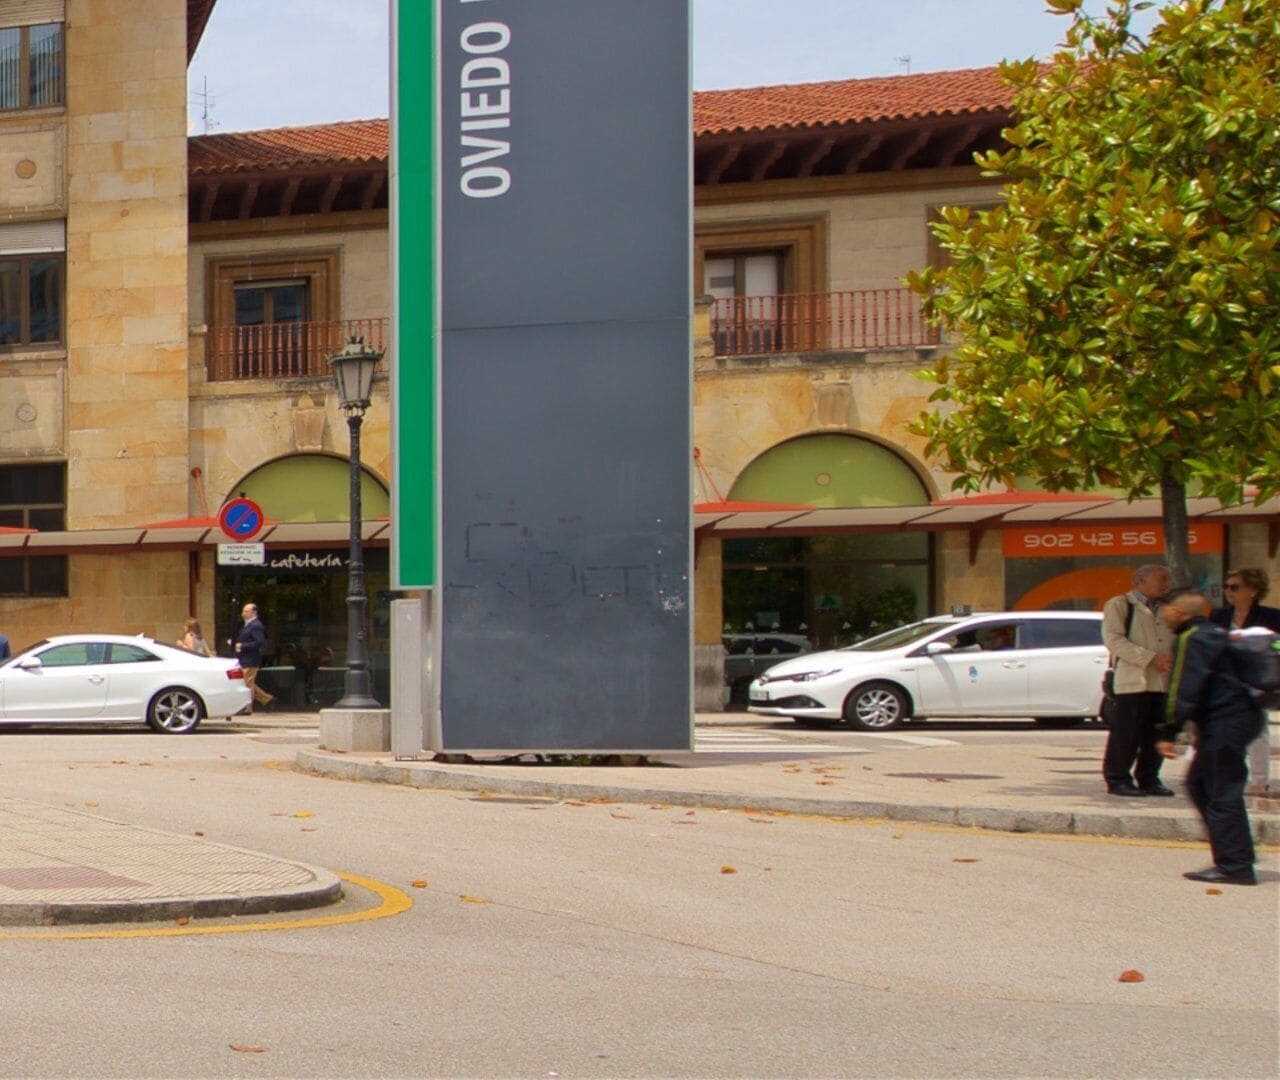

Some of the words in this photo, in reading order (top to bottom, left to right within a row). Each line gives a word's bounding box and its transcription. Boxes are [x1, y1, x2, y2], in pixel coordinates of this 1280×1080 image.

[460, 21, 511, 198] OVIEDO
[1024, 534, 1074, 548] 902
[1081, 532, 1114, 546] 42
[1122, 531, 1157, 546] 56
